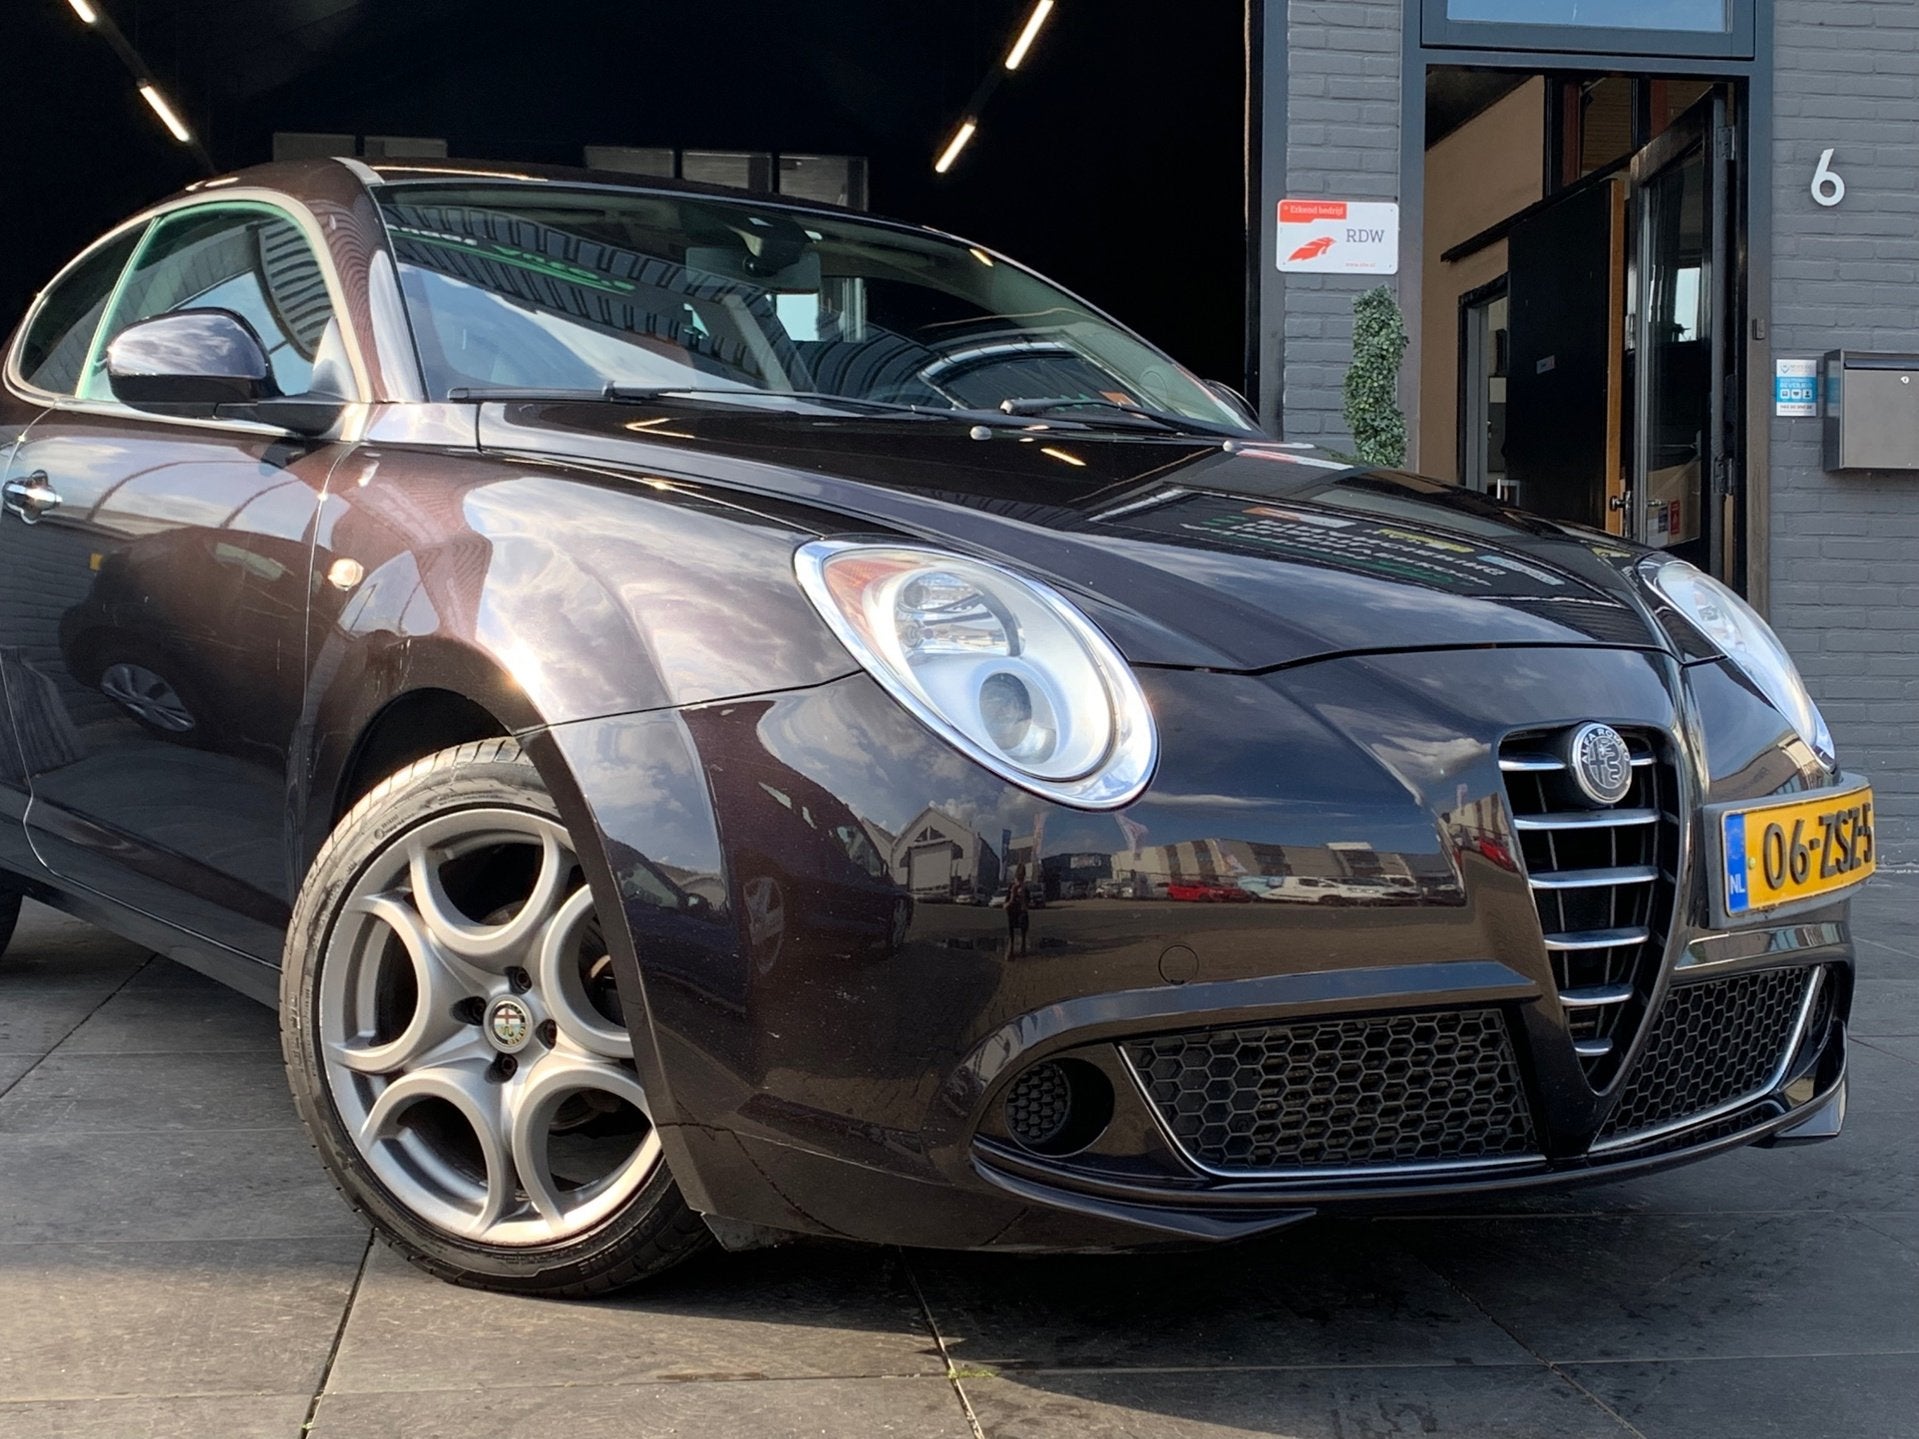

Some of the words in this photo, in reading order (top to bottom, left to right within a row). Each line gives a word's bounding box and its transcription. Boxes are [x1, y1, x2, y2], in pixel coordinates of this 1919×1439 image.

[1811, 148, 1845, 206] 6
[1346, 228, 1385, 243] RDW
[1729, 874, 1746, 895] NL
